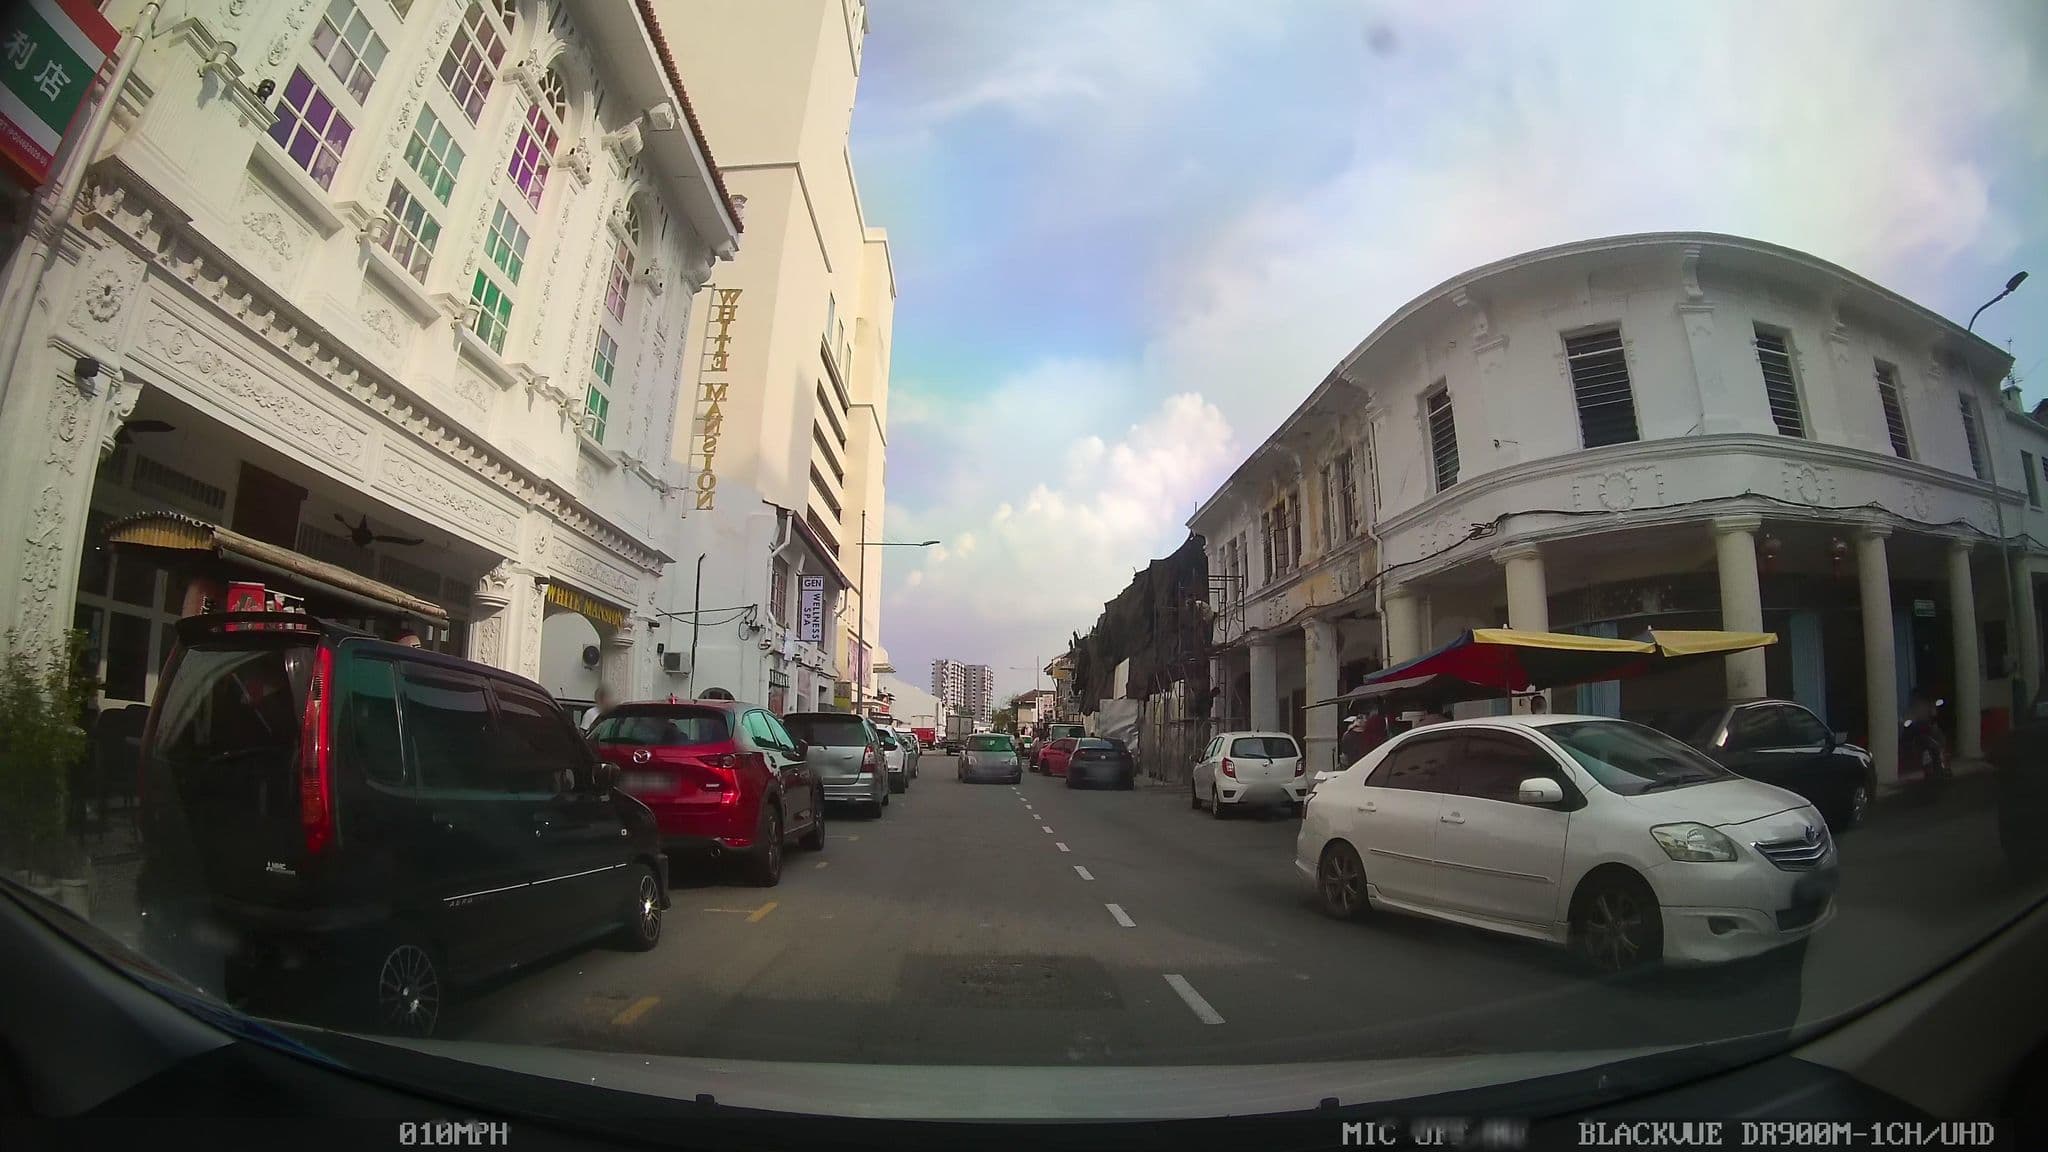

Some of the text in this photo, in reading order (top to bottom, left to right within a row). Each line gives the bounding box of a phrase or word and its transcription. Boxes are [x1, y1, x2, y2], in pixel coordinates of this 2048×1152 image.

[804, 579, 822, 587] GEN
[547, 584, 624, 630] WHITE MANSION
[803, 607, 812, 626] SPA
[812, 593, 821, 639] WELLNESS
